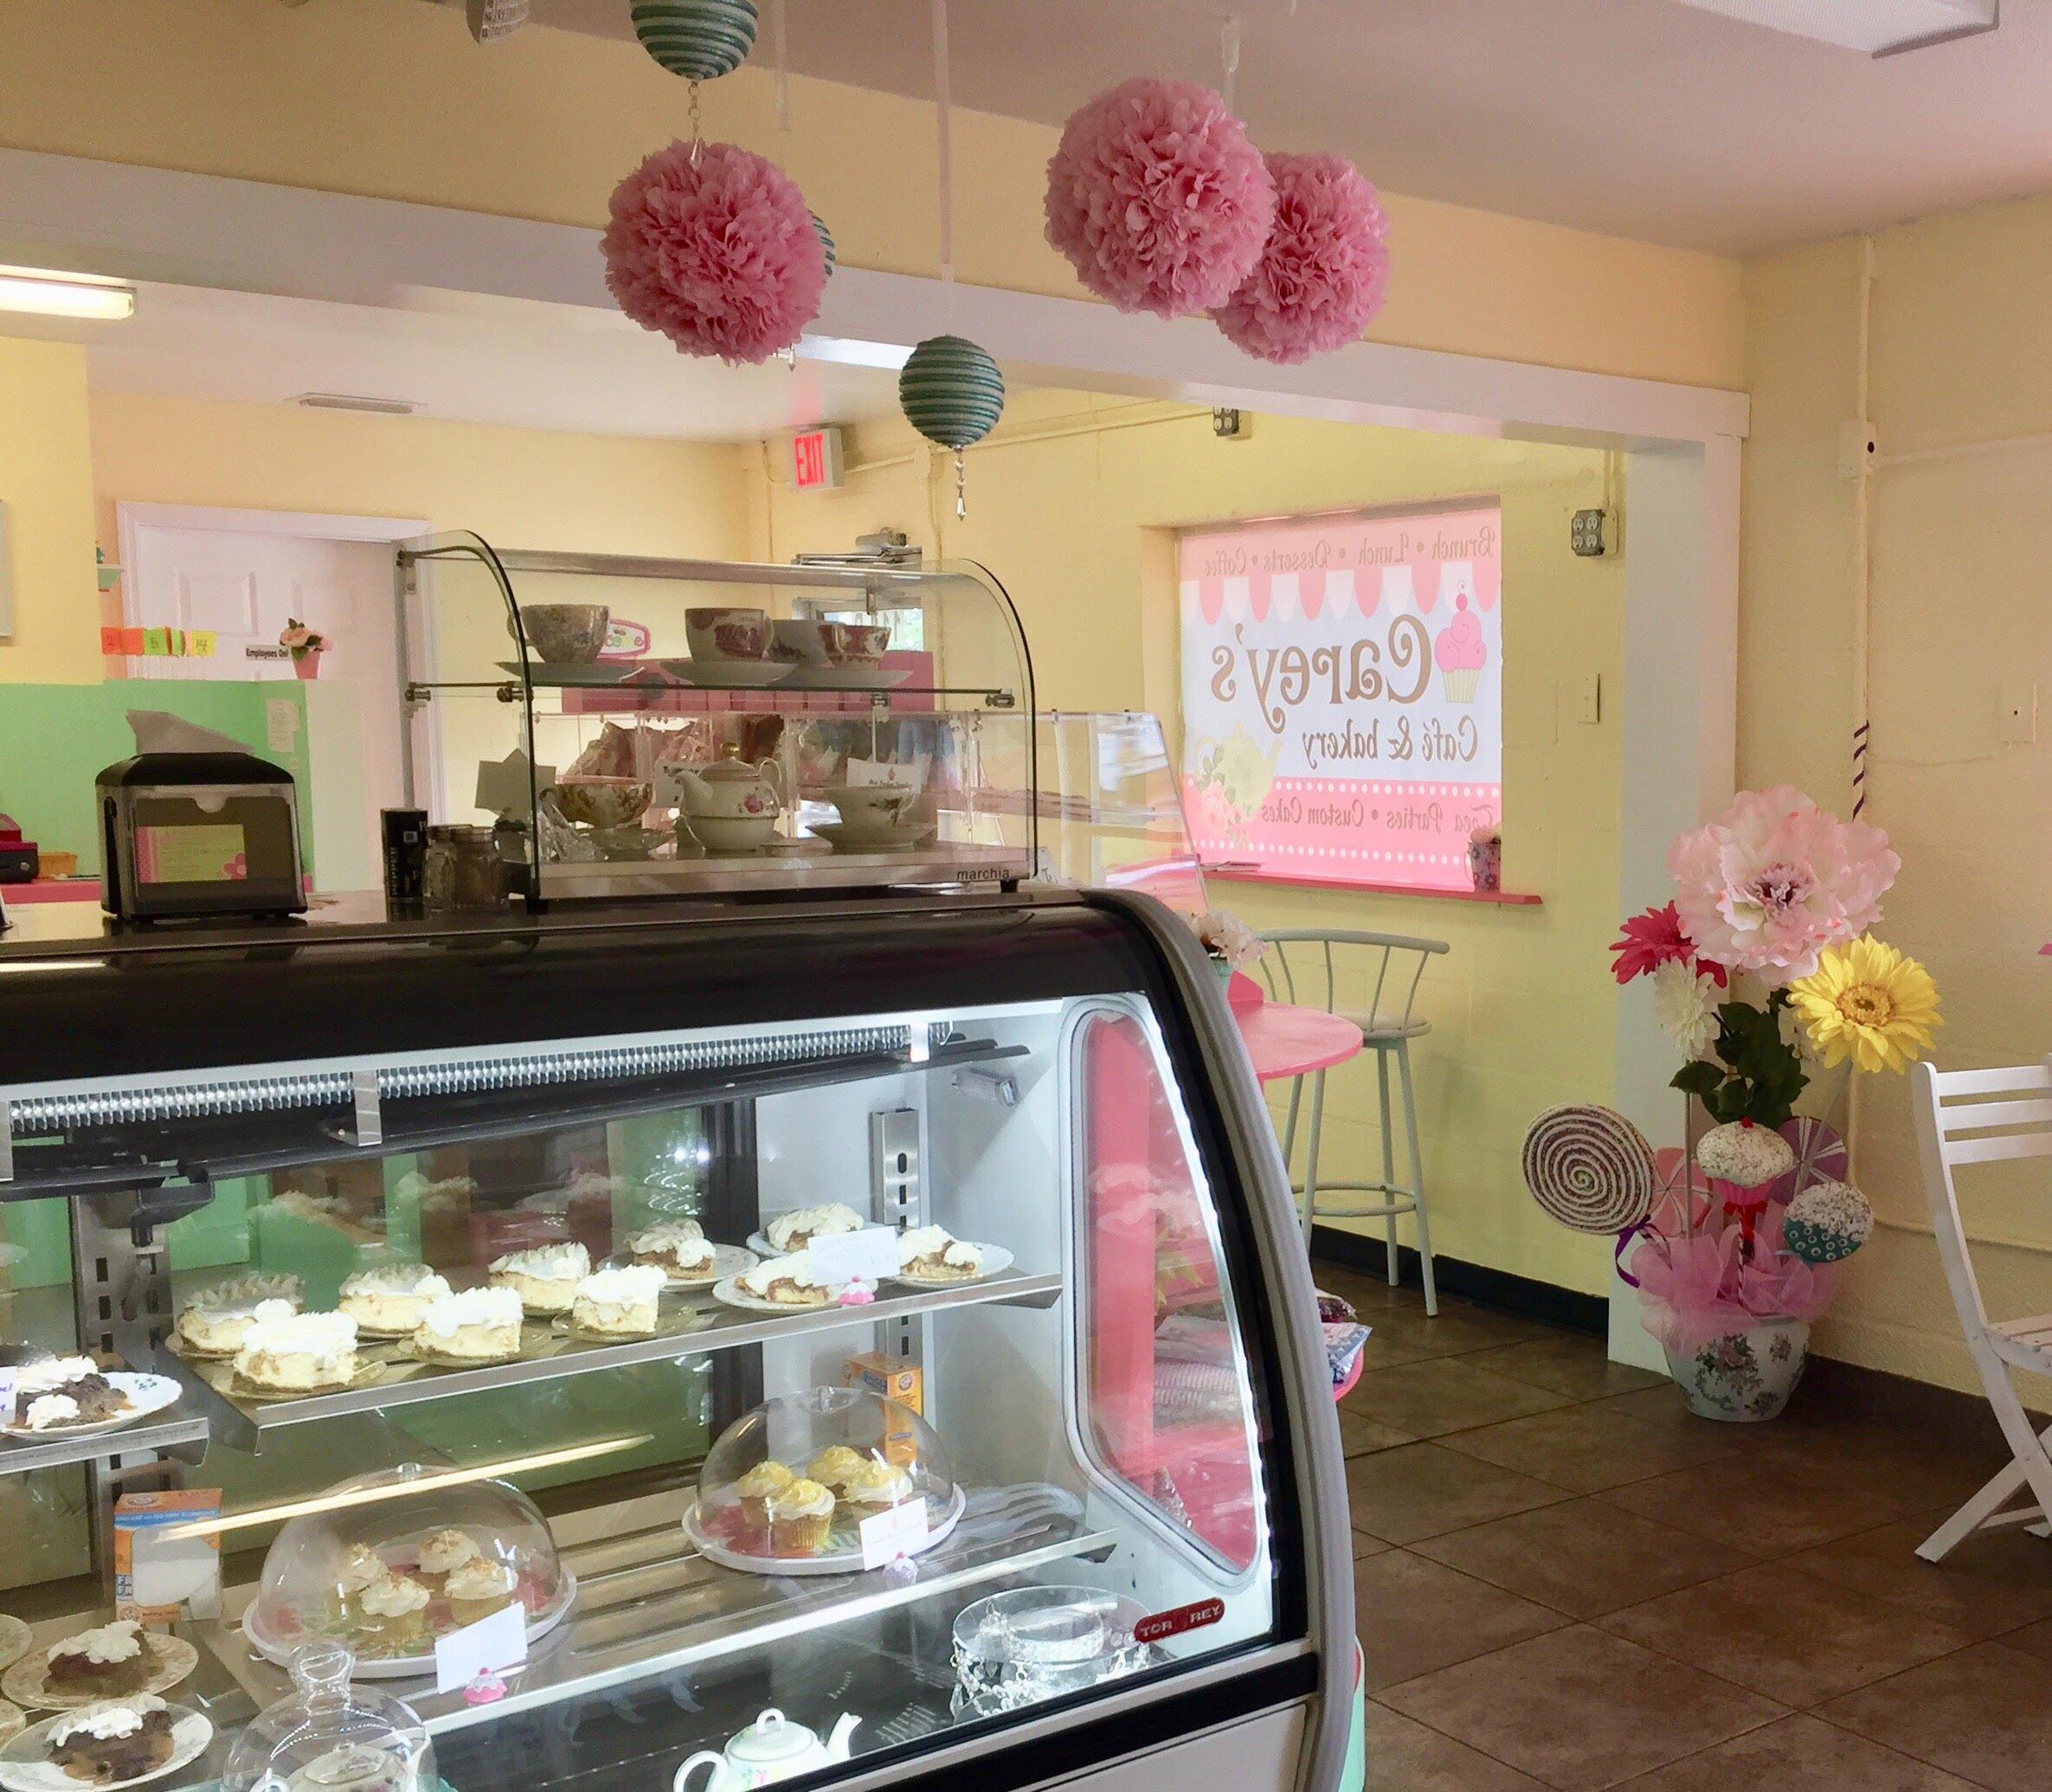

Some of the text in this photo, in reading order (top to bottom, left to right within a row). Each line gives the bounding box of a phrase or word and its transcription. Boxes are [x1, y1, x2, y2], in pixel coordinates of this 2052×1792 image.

[794, 434, 825, 487] EXIT
[246, 647, 277, 659] Employees
[956, 867, 1010, 880] marchia
[1189, 1605, 1221, 1623] REY
